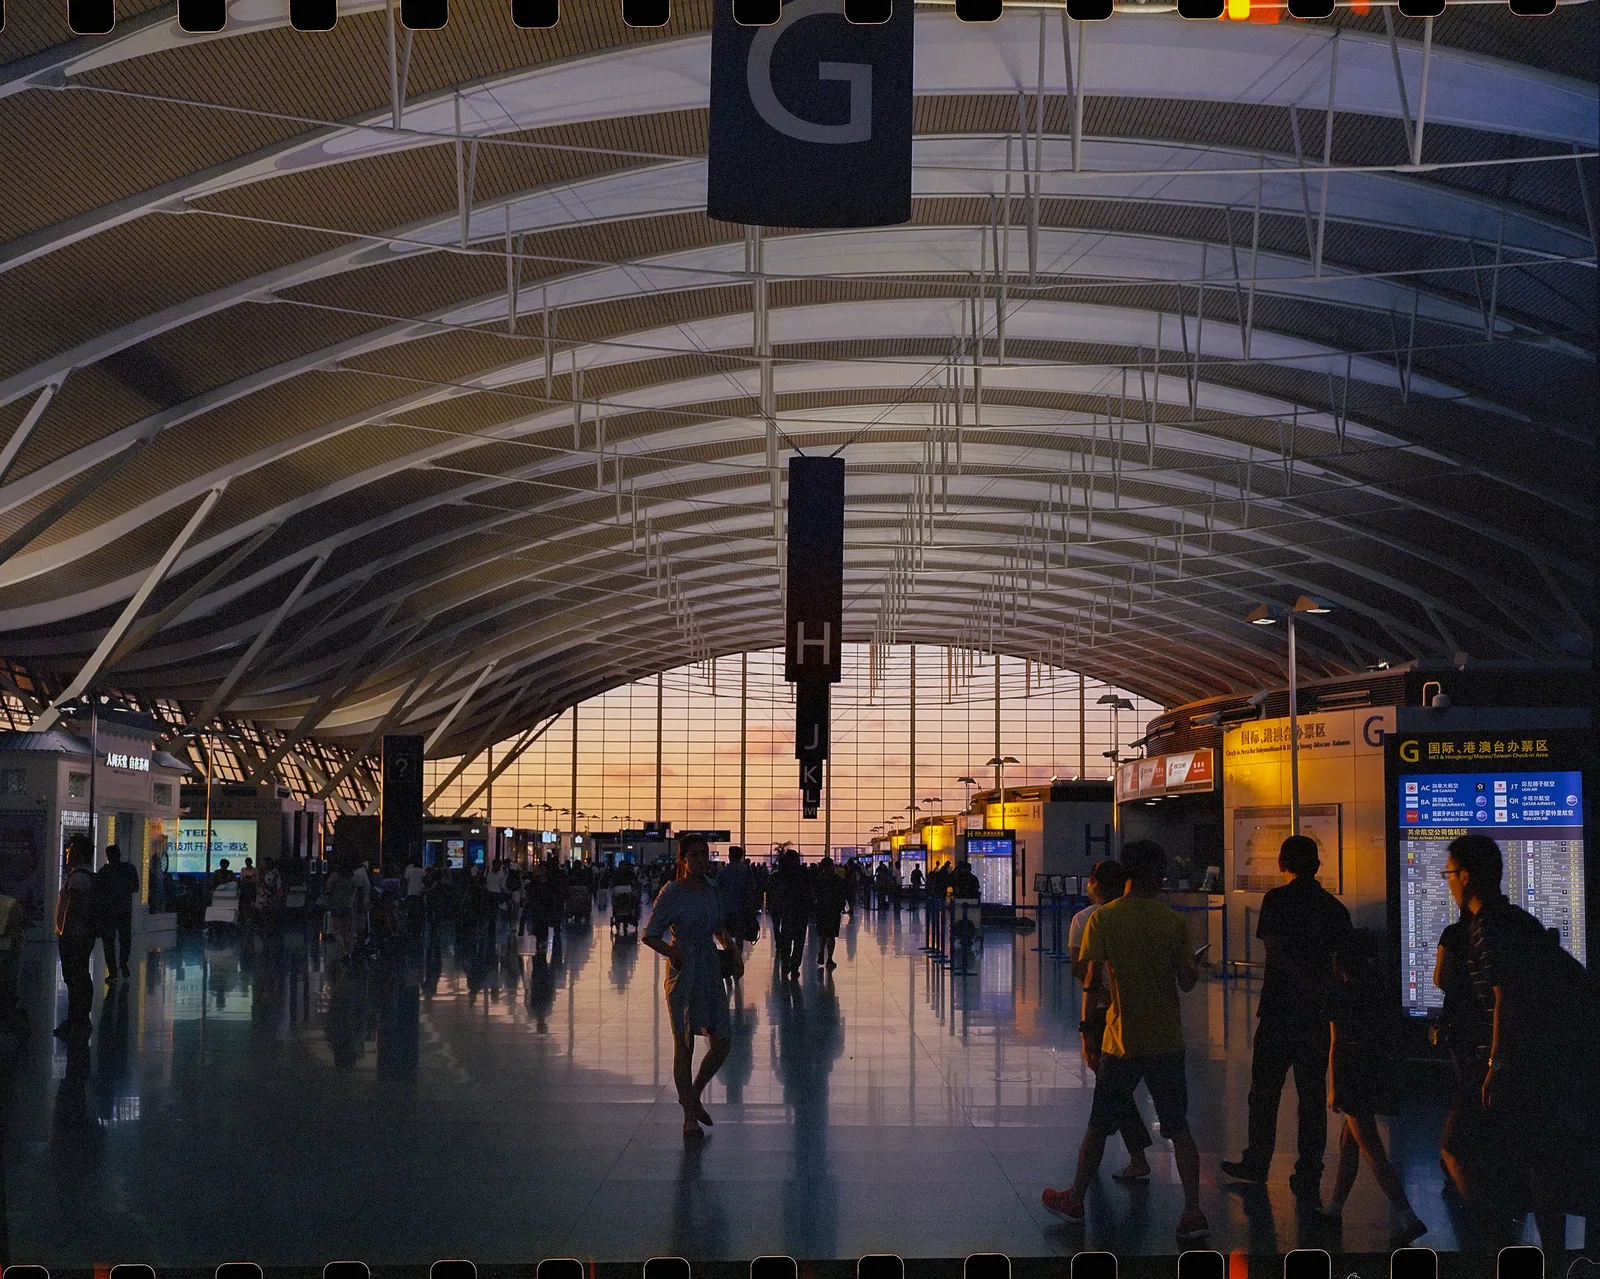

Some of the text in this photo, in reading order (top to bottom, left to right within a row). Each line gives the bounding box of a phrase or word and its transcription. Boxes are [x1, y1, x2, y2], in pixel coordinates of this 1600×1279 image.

[747, 0, 873, 144] G
[797, 622, 831, 665] H
[804, 724, 819, 750] J
[1363, 716, 1384, 747] G
[1400, 740, 1419, 763] G
[1428, 740, 1548, 755] 国际、港澳台办票区
[804, 766, 818, 783] K
[806, 790, 816, 802] L
[1033, 805, 1040, 818] H
[184, 829, 218, 837] TEDA
[1085, 823, 1111, 857] H
